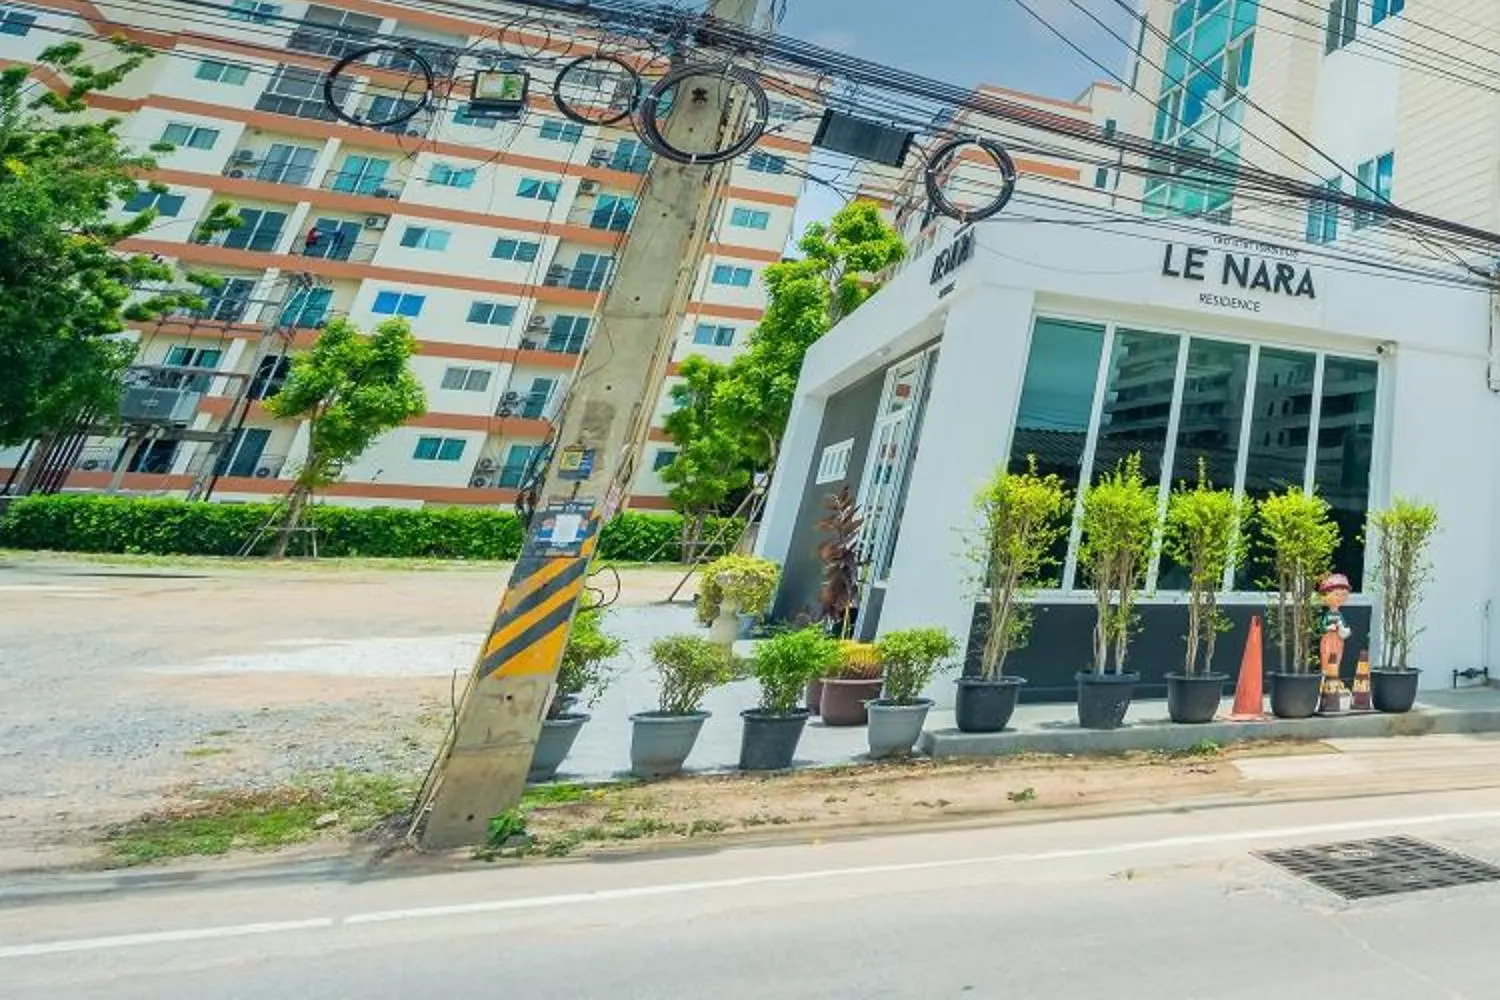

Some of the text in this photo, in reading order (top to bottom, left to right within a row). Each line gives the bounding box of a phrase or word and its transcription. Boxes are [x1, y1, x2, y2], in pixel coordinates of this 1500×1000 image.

[1161, 243, 1208, 281] LE
[1221, 253, 1316, 299] NARA
[1199, 293, 1261, 312] RESIDENCE
